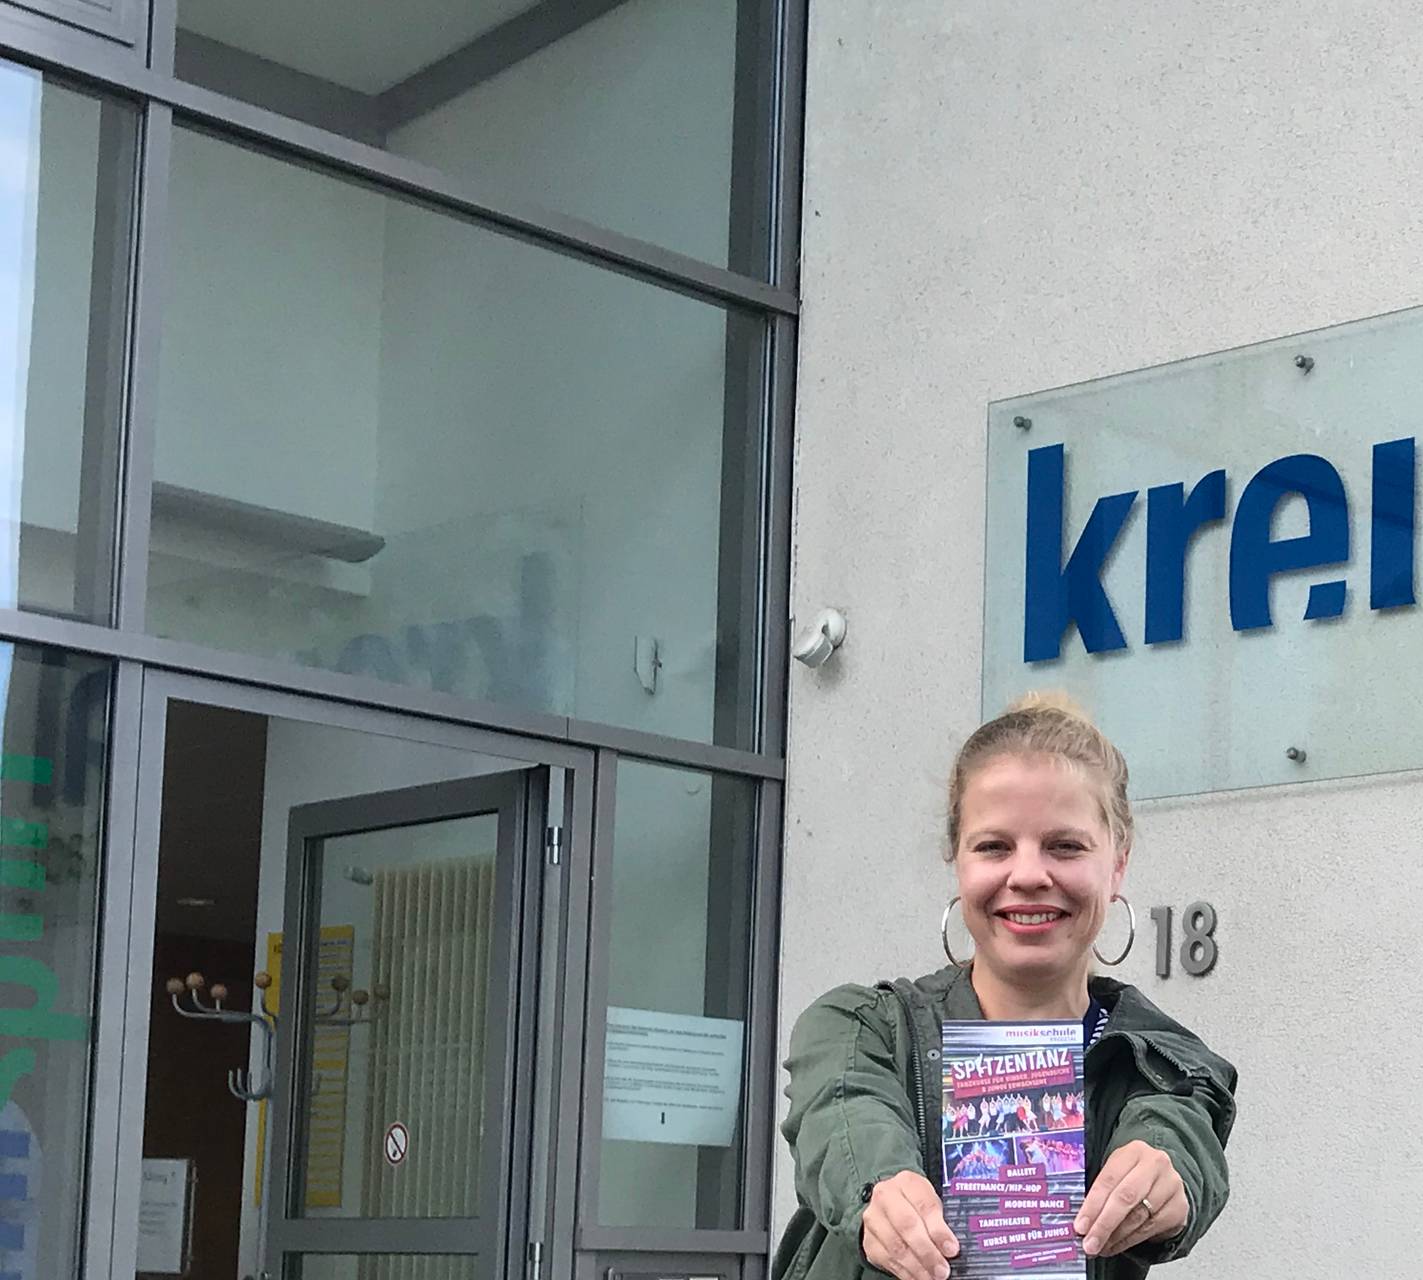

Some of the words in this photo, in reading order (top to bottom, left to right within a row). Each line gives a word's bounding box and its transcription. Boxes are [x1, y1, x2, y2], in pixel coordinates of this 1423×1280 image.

[1150, 901, 1218, 979] 18
[1005, 1027, 1077, 1038] musikschule
[952, 1048, 1070, 1080] SPITZENTANZ
[1007, 1167, 1036, 1177] BALLETT
[955, 1182, 1041, 1192] STREETDANCE/HIP-HOP
[1004, 1200, 1038, 1208] MODERN
[1039, 1200, 1065, 1208] DANCE
[978, 1217, 1031, 1228] TANZTHEATER
[983, 1236, 1008, 1247] KURSE
[1009, 1233, 1026, 1243] NUR
[1028, 1230, 1043, 1240] FÜR
[1044, 1227, 1070, 1239] JUNGS
